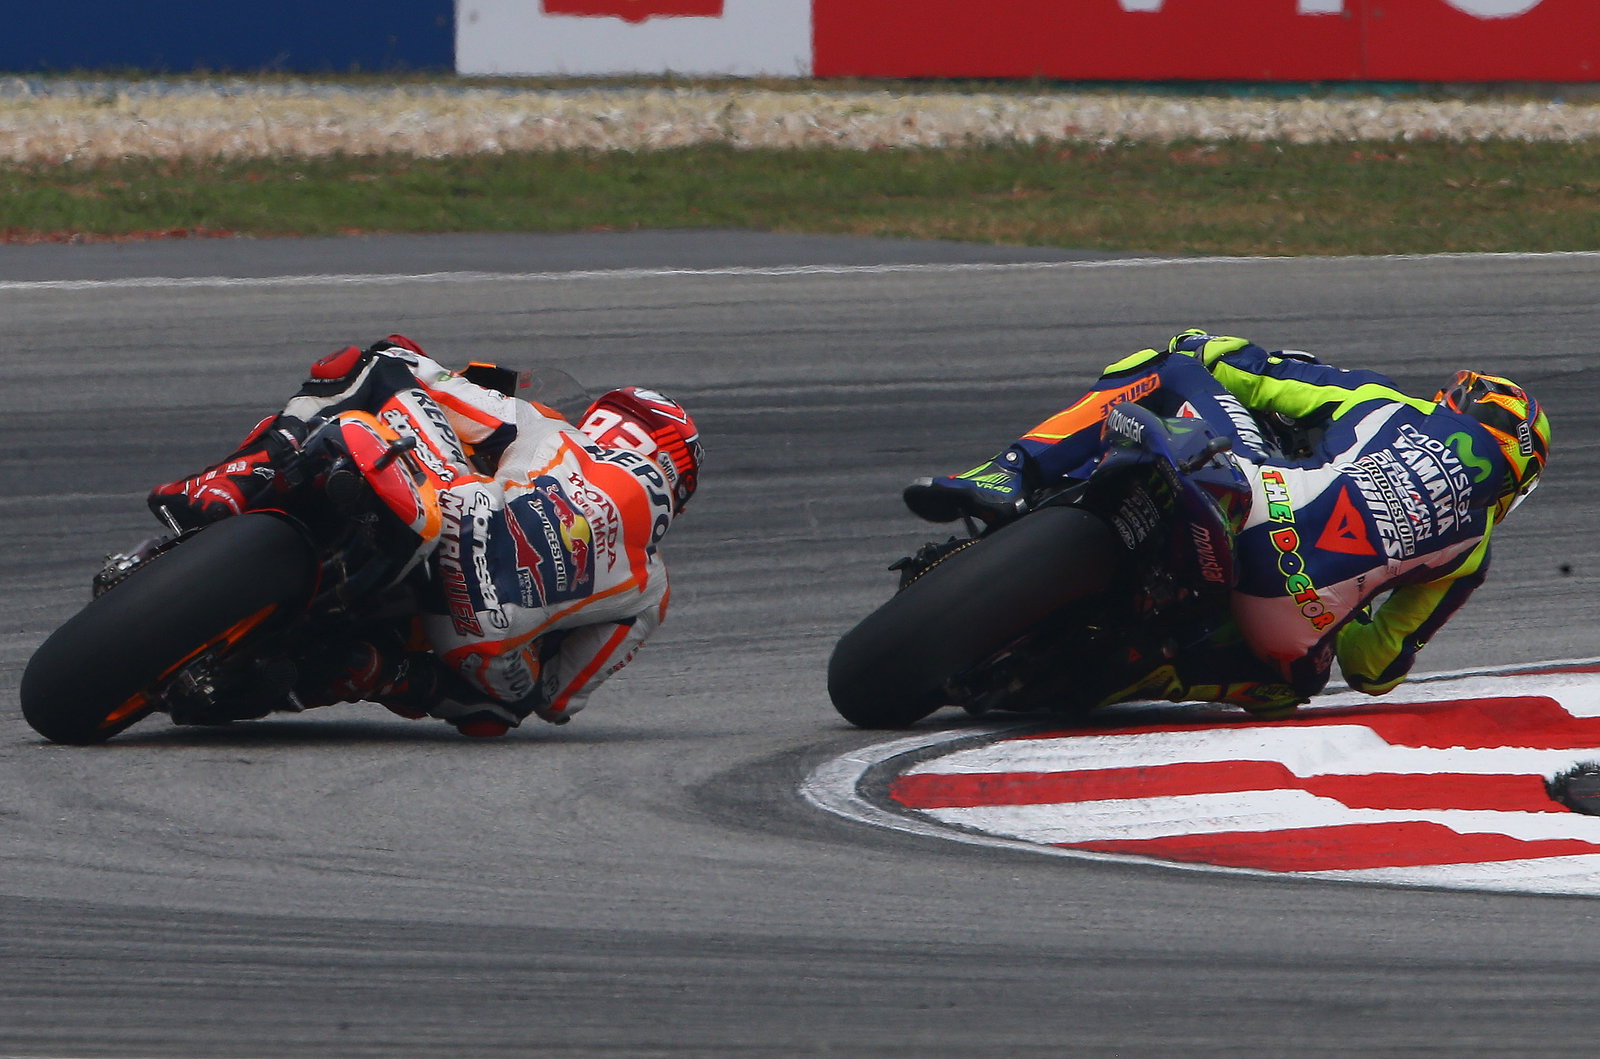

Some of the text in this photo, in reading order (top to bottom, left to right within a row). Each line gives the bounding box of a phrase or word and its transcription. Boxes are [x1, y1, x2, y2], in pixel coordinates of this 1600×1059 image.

[568, 472, 618, 573] HONDA
[1260, 470, 1295, 523] THE
[1392, 435, 1454, 536] YAMAHA
[438, 490, 485, 637] MARQUEZ
[1269, 527, 1336, 632] DOCTOR
